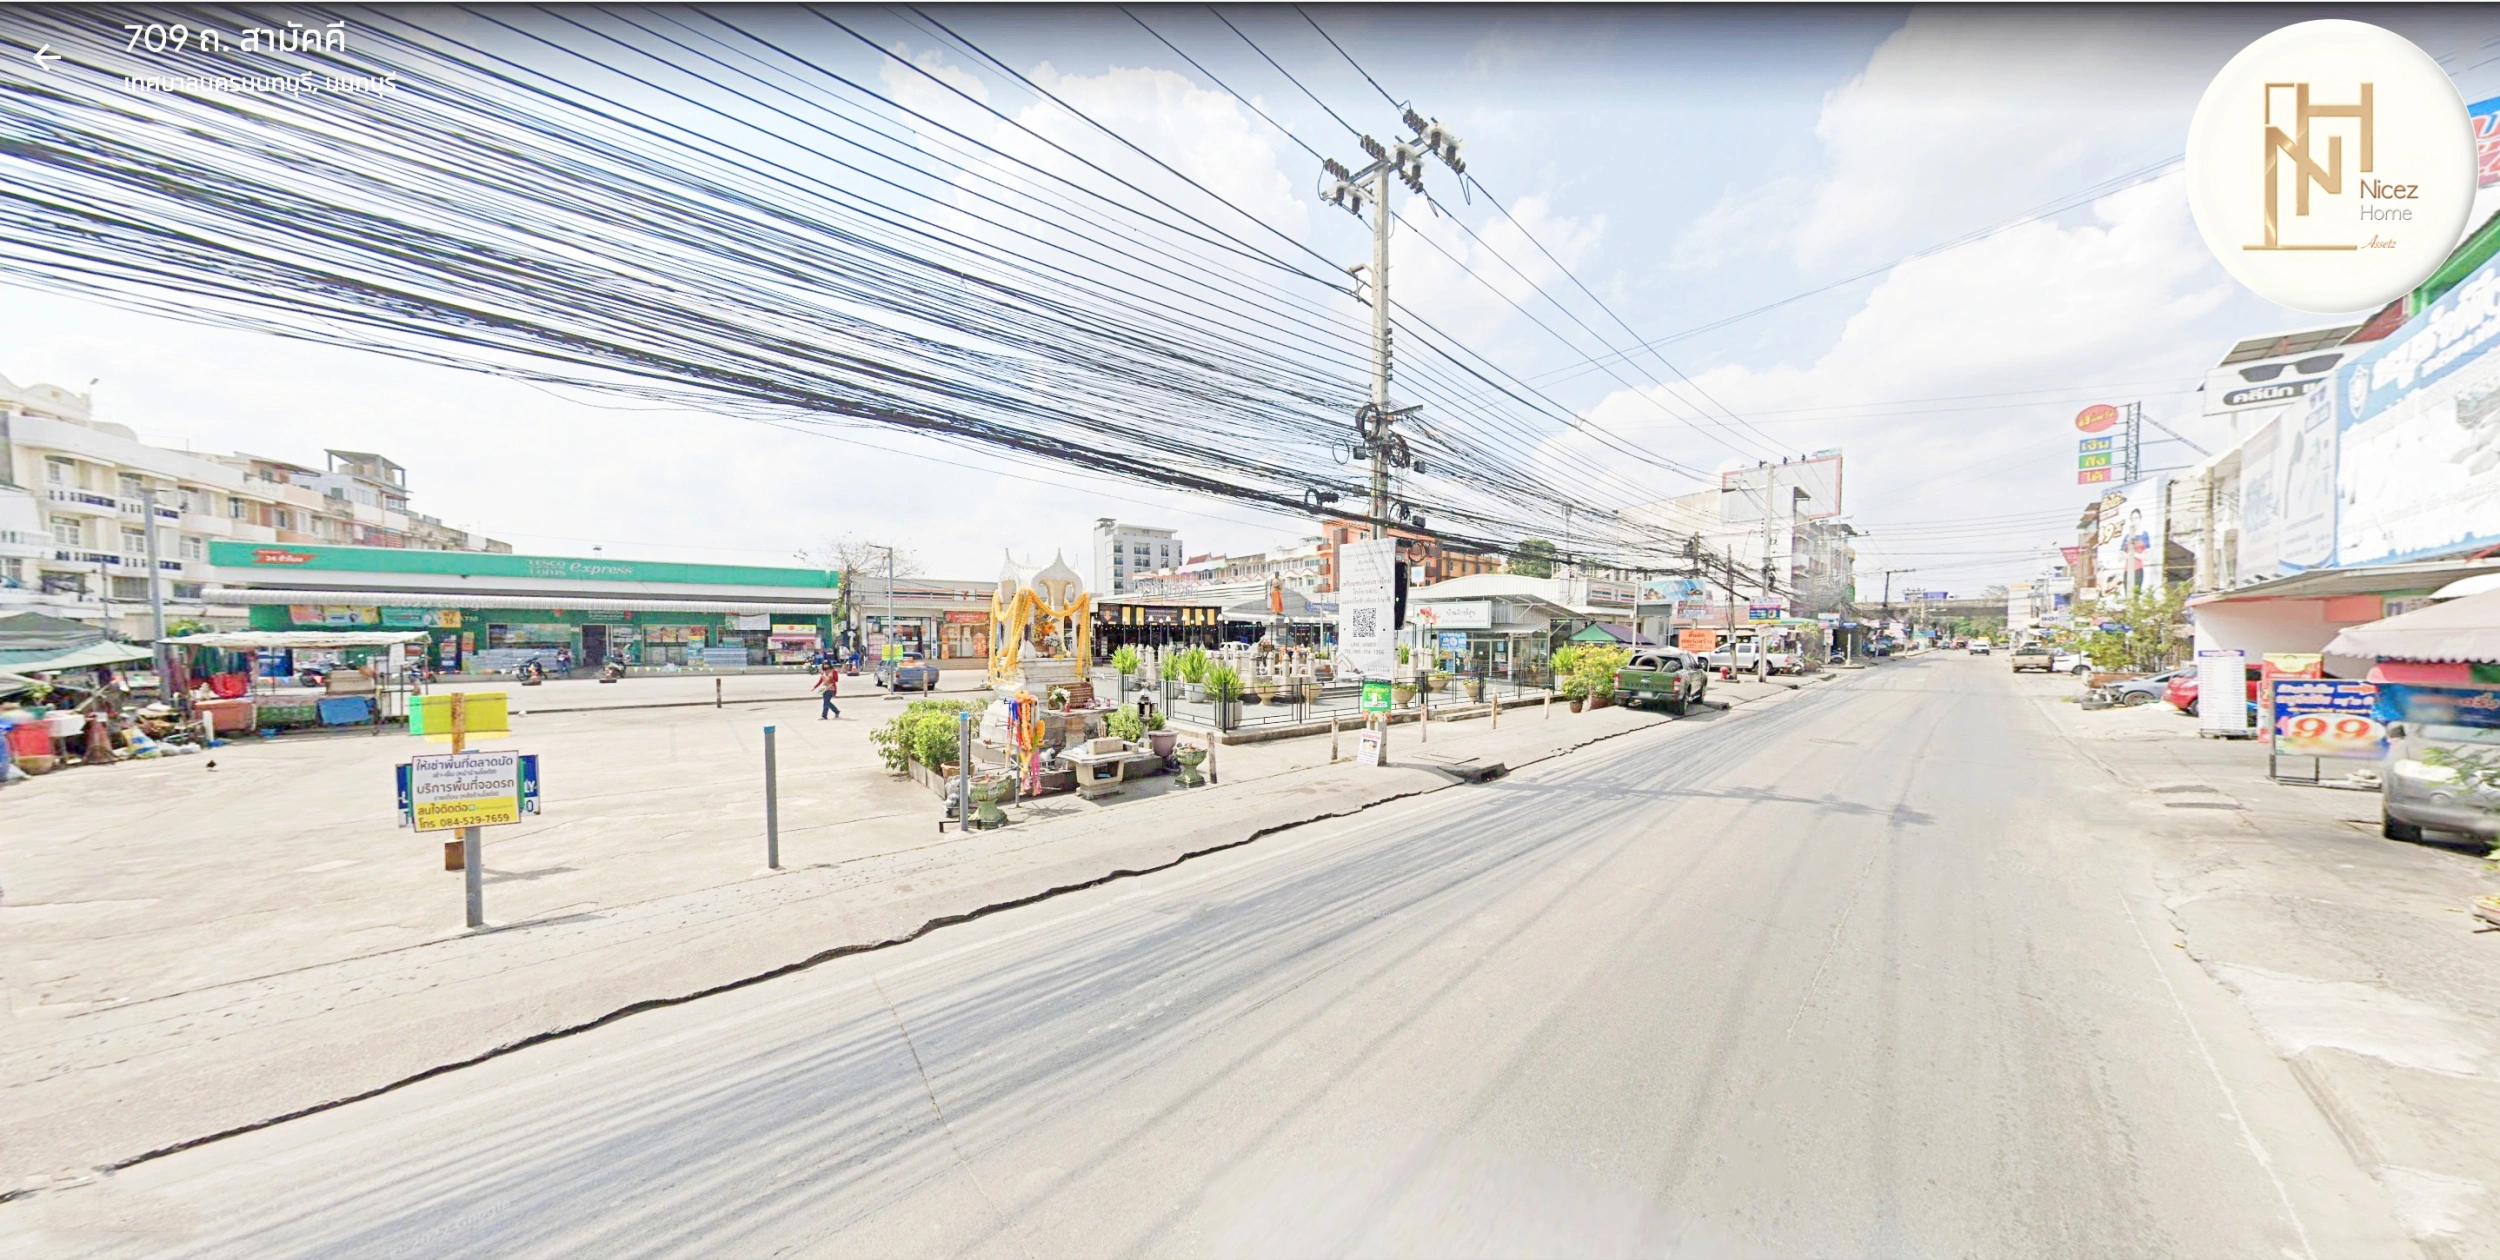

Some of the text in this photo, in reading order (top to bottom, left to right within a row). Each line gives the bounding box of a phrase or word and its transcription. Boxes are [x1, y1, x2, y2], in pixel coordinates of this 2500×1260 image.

[570, 562, 633, 576] express
[416, 755, 513, 771] ให้เช่าพื้นที่ตลาดนัด
[416, 776, 514, 795] บริการพื้นที่จอดรถ
[418, 803, 468, 815] สนใจติดต่อ
[418, 813, 510, 828] โทร 084-529-7659
